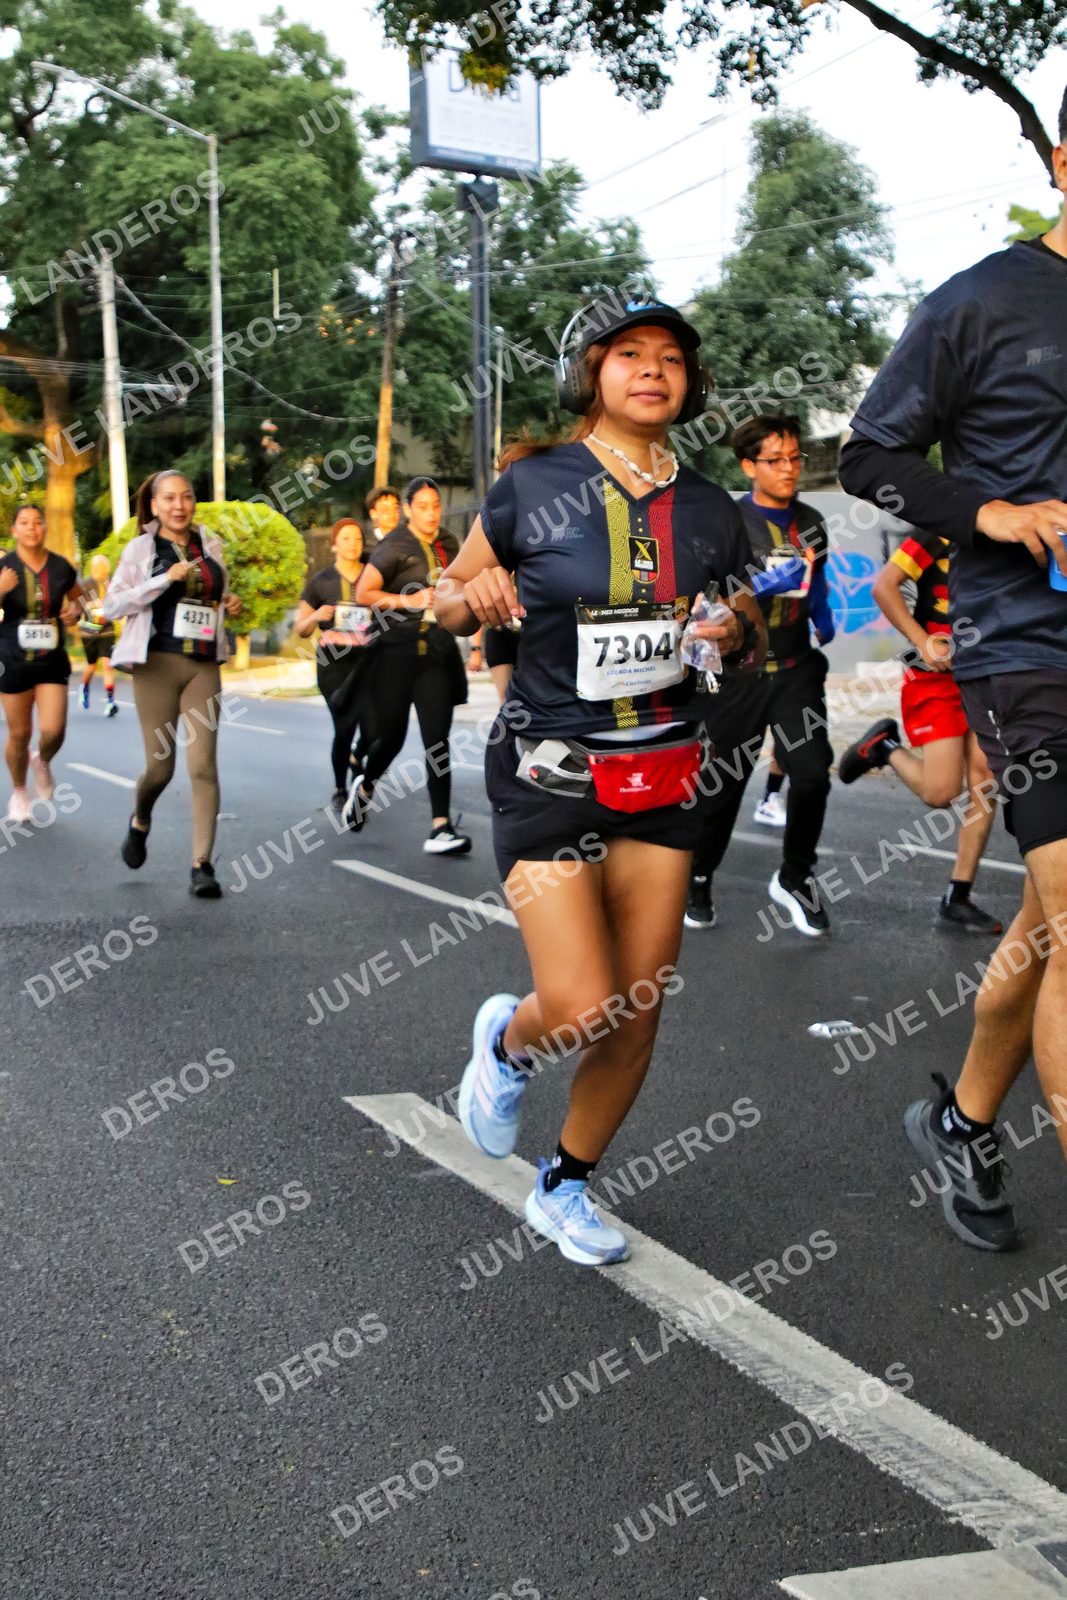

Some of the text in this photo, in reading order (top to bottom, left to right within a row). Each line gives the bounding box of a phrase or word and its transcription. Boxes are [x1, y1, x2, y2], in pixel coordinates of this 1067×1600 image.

[183, 610, 210, 625] 4321
[25, 629, 51, 639] 5816
[593, 632, 673, 668] 7304
